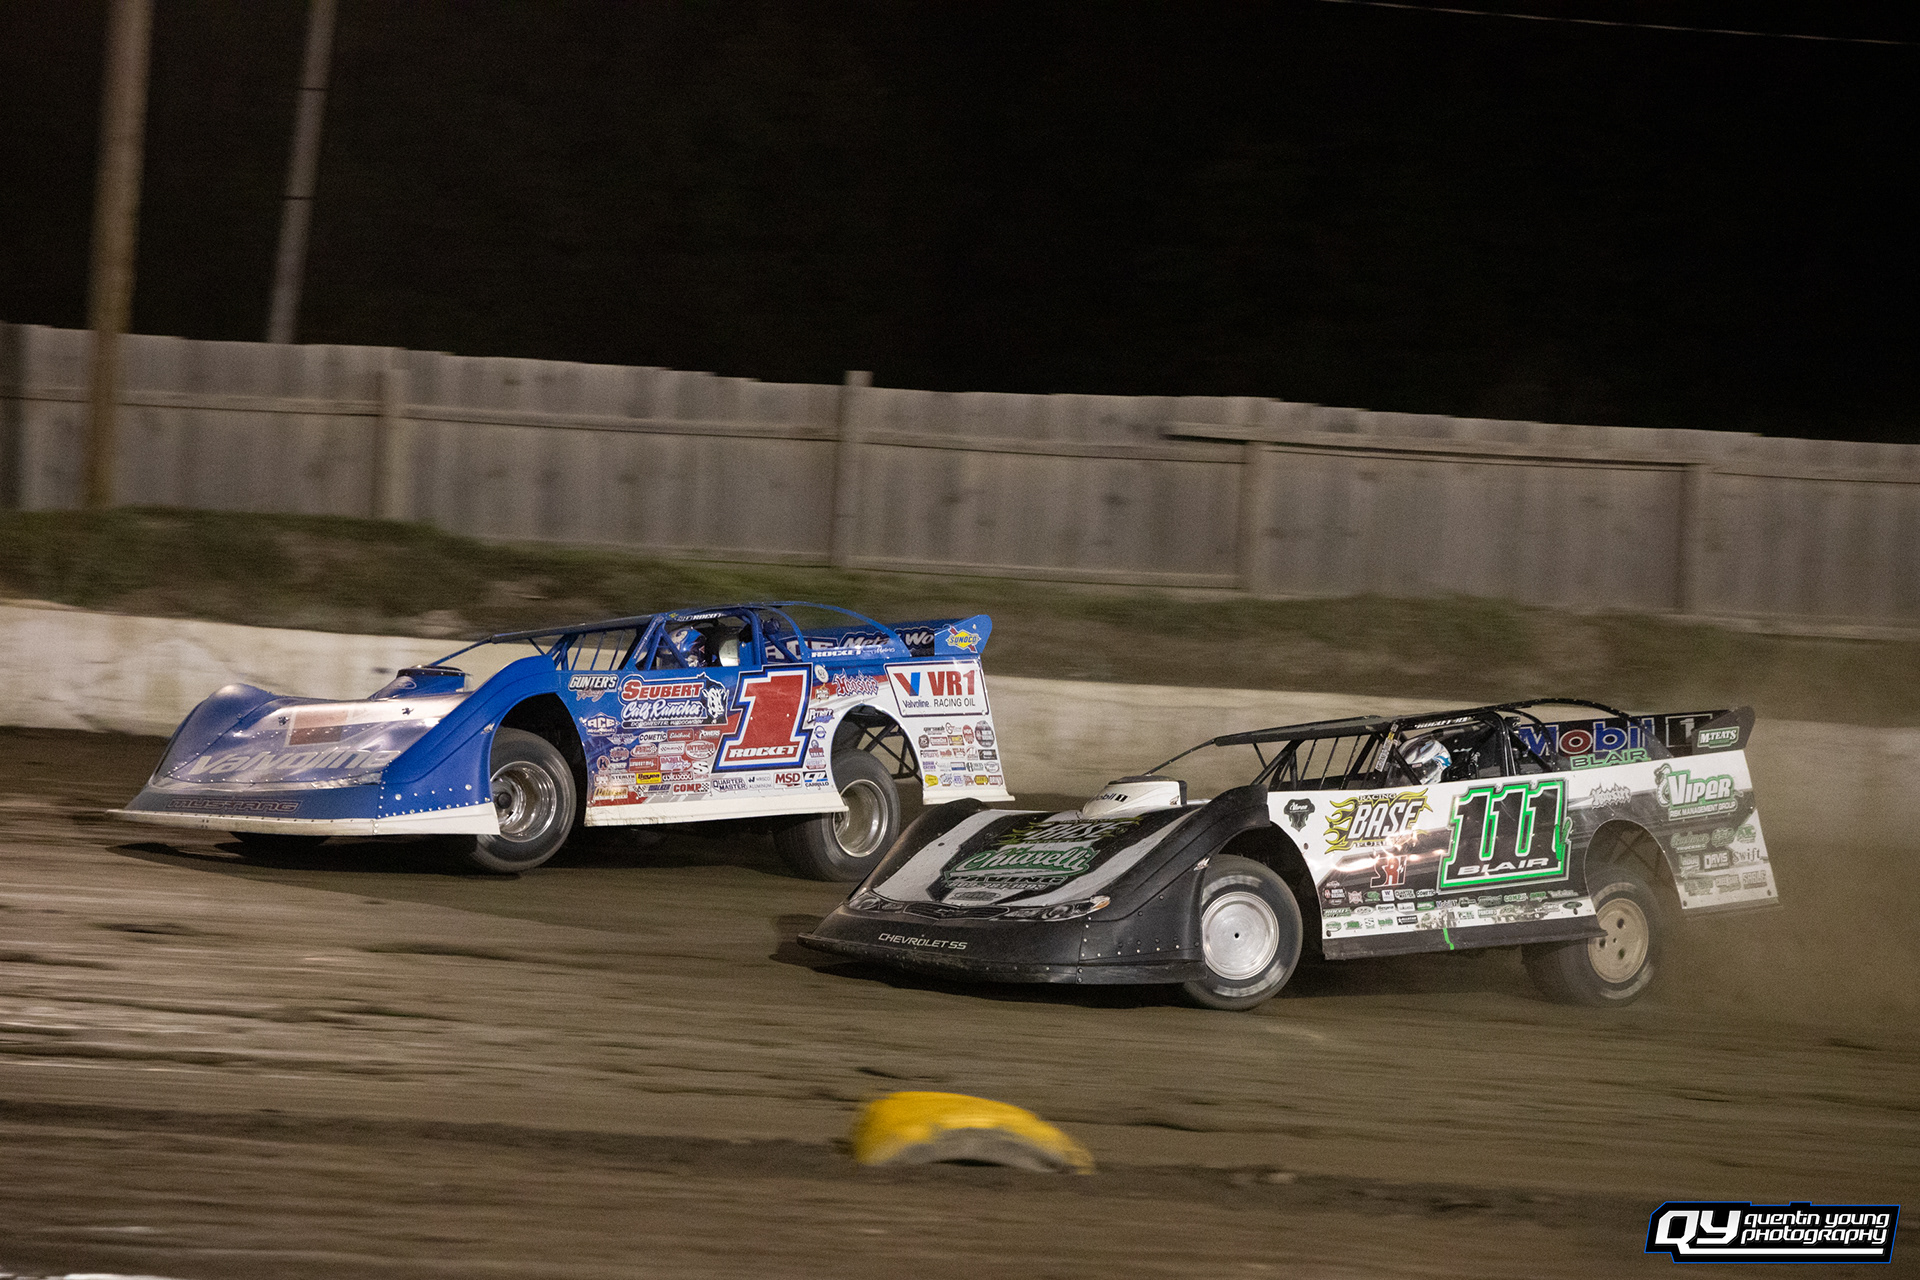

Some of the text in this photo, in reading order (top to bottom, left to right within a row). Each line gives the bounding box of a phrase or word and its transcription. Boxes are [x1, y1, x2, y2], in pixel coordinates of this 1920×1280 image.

[949, 636, 977, 646] SUNOCO
[569, 676, 617, 689] GUNTER'S
[622, 680, 703, 701] SEUBERT
[834, 673, 878, 696] Hoosier
[927, 670, 975, 697] VR1
[650, 698, 702, 719] Ranches
[902, 697, 976, 709] Valvoline RACING OIL
[588, 717, 615, 729] ACE
[722, 672, 806, 764] 1
[639, 733, 667, 741] COMETIC
[1519, 719, 1655, 758] Mobil
[728, 745, 798, 758] ROCKET
[1572, 749, 1647, 768] BLAIR
[188, 746, 402, 776] Valvoline
[713, 779, 743, 788] QUARTER
[775, 773, 801, 783] MSD
[673, 783, 703, 792] COMP
[1094, 793, 1117, 802] obil
[1358, 793, 1397, 801] RACING
[1682, 804, 1718, 816] MANAGEMENT
[1718, 801, 1736, 810] GROUP
[1348, 801, 1424, 840] BASE
[1444, 784, 1562, 884] 111
[955, 847, 1090, 871] Chiarelli
[1732, 848, 1761, 864] Swift
[1457, 857, 1550, 876] BLAIR
[878, 932, 968, 950] CHEVROLET SS
